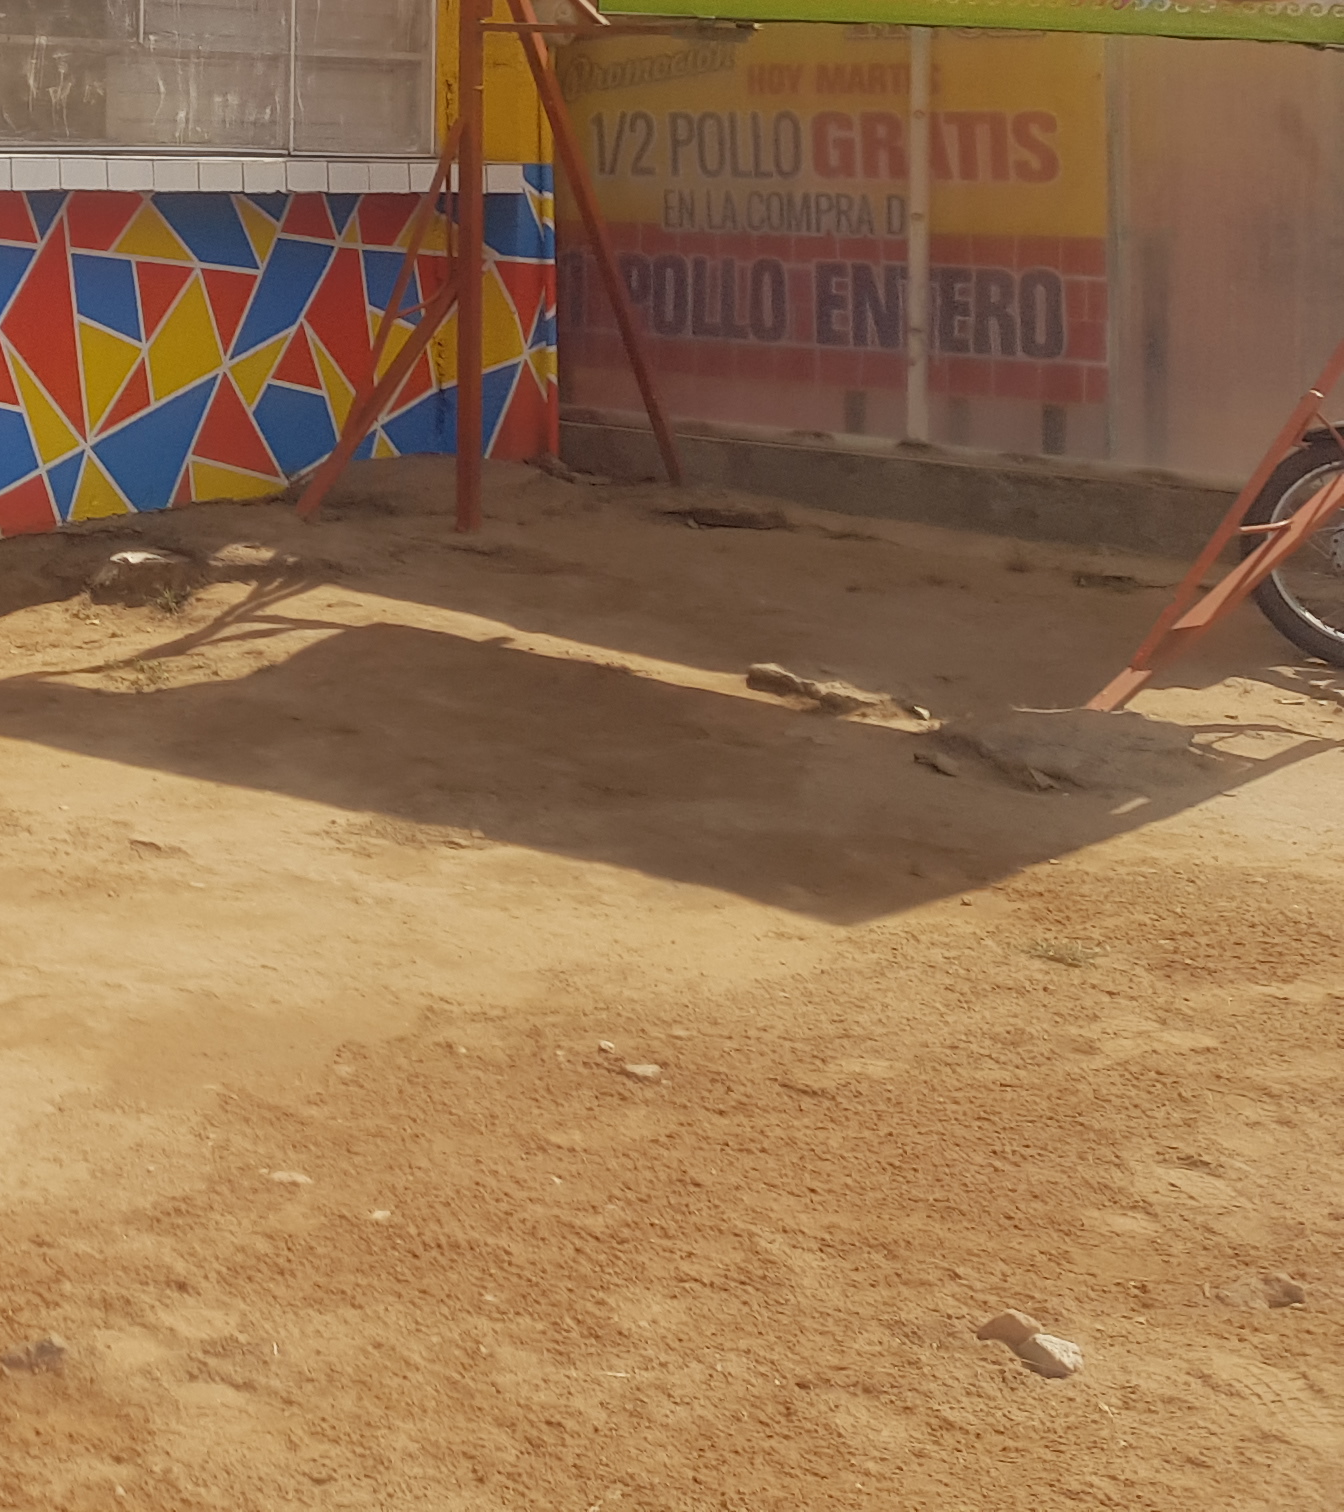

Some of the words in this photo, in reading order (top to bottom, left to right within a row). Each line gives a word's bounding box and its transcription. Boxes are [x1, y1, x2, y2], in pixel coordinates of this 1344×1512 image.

[746, 62, 804, 95] HOY
[589, 110, 656, 178] 1/2
[668, 110, 803, 181] POLLO
[663, 188, 697, 231] EN
[706, 190, 739, 232] LA
[747, 191, 876, 237] COMPRA
[886, 196, 907, 235] D
[618, 250, 787, 344] POLLO
